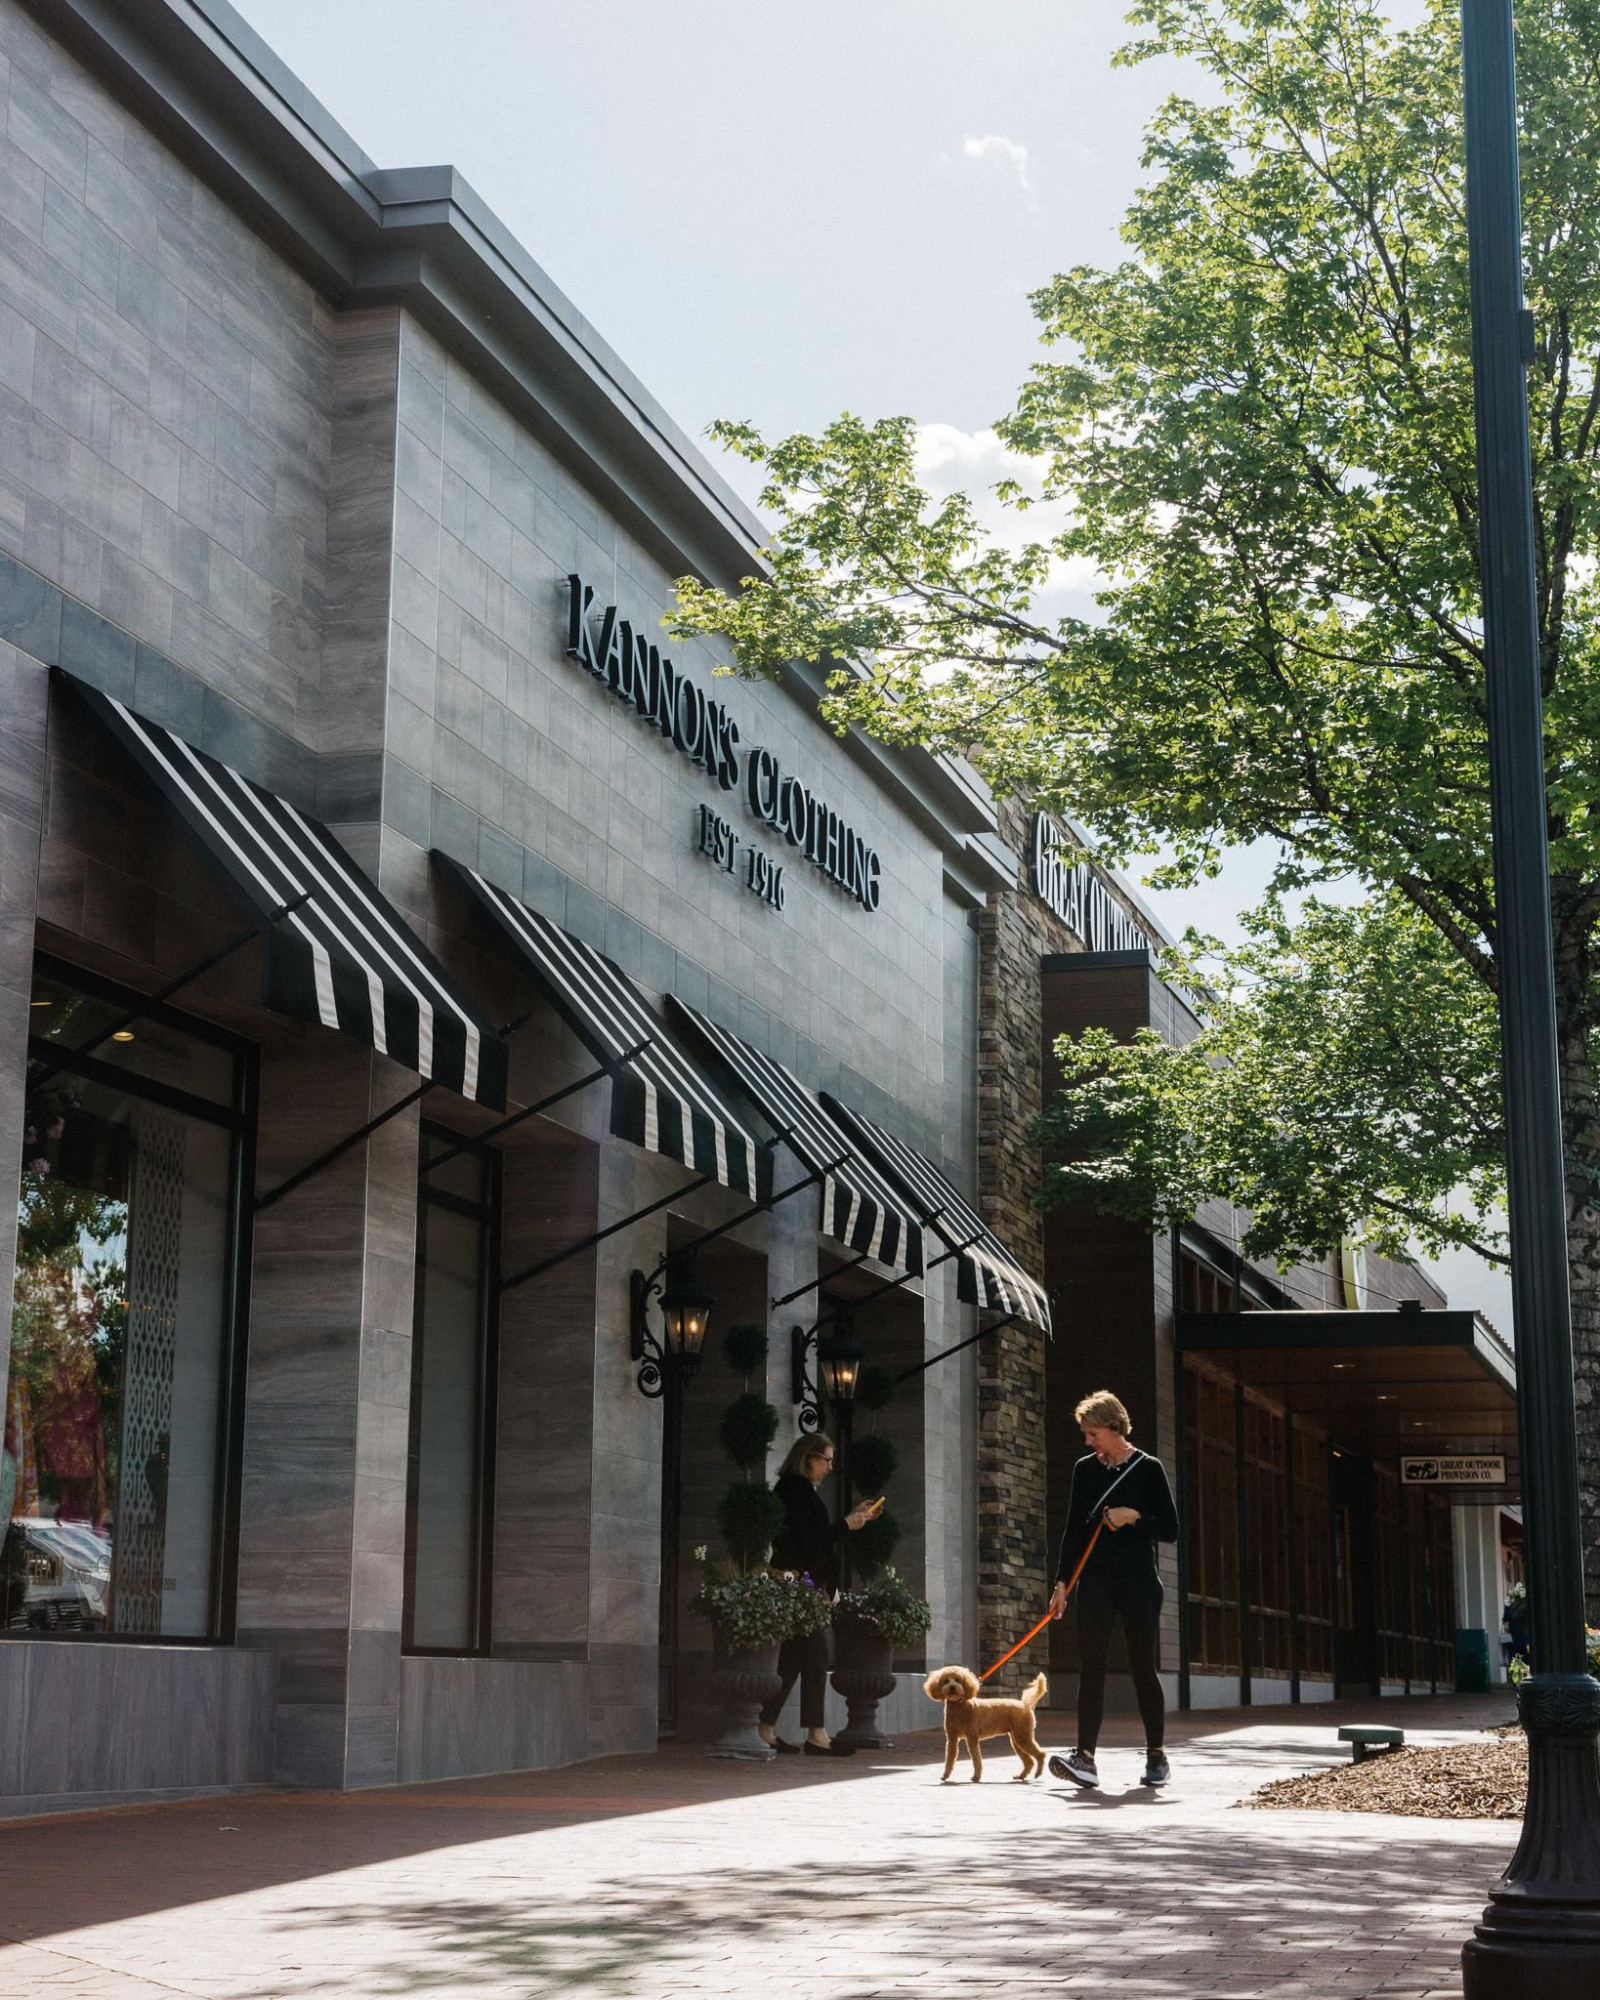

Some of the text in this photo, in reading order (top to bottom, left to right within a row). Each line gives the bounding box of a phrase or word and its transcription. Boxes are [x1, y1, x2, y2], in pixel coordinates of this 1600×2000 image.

[566, 573, 881, 913] KANNON'S CLOTHING
[699, 803, 787, 912] EST 1916
[1440, 1460, 1501, 1470] GREAT OUTDOOR
[1441, 1470, 1480, 1480] PROVISION
